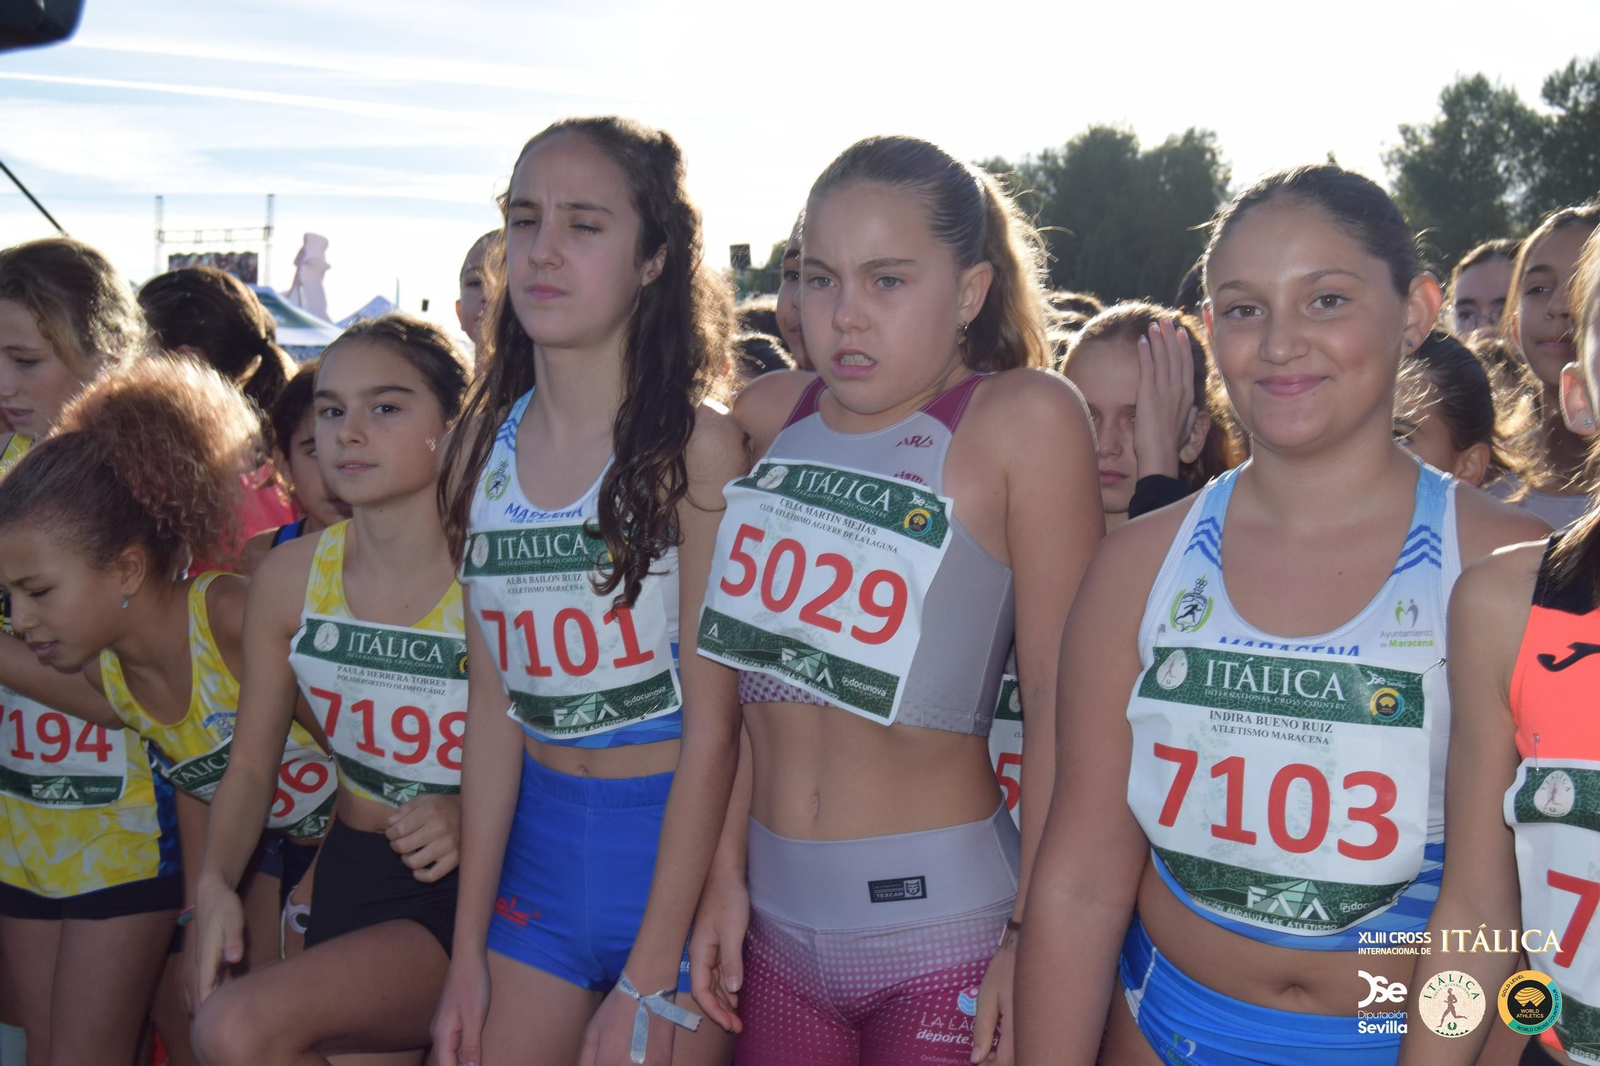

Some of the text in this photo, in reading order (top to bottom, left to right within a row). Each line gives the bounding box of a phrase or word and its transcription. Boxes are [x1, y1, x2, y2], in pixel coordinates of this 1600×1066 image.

[796, 470, 891, 512] ITÁLICA
[759, 503, 898, 554] CLUB ATLETISMO AGUERE DE LA LAGUNA
[801, 506, 841, 523] MARTÍN
[842, 517, 878, 535] MEJÍAS
[497, 531, 589, 560] ITÁLICA
[506, 575, 528, 585] ALBA
[562, 573, 582, 582] RUIZ
[507, 584, 584, 595] ATLETISMO MARACENA
[719, 523, 908, 645] 5029
[480, 604, 655, 677] 7101
[1380, 629, 1433, 639] Ayuntamiento
[1389, 639, 1434, 648] Maracena
[348, 630, 443, 663] ITÁLICA
[337, 665, 446, 688] PAULA HERRERA TORRES
[337, 674, 446, 696] POLIDEPORTIVO OLIMPO CÁDIZ
[850, 678, 887, 697] docunova
[1205, 657, 1347, 701] ITÁLICA
[632, 686, 666, 703] docunova
[1204, 688, 1346, 711] INTERNATIONAL CROSS COUNTRY
[309, 686, 468, 771] 7198
[1209, 710, 1333, 733] INDIRA BUENO RUIZ
[0, 704, 113, 764] 194
[1210, 723, 1329, 745] ATLETISMO MARACENA
[1153, 742, 1400, 861] 7103
[875, 891, 904, 899] TEXCAN
[1226, 907, 1270, 924] ANDALUZA
[1272, 916, 1284, 926] DE
[1287, 920, 1338, 931] ATLETISMO
[1547, 868, 1600, 968] 7
